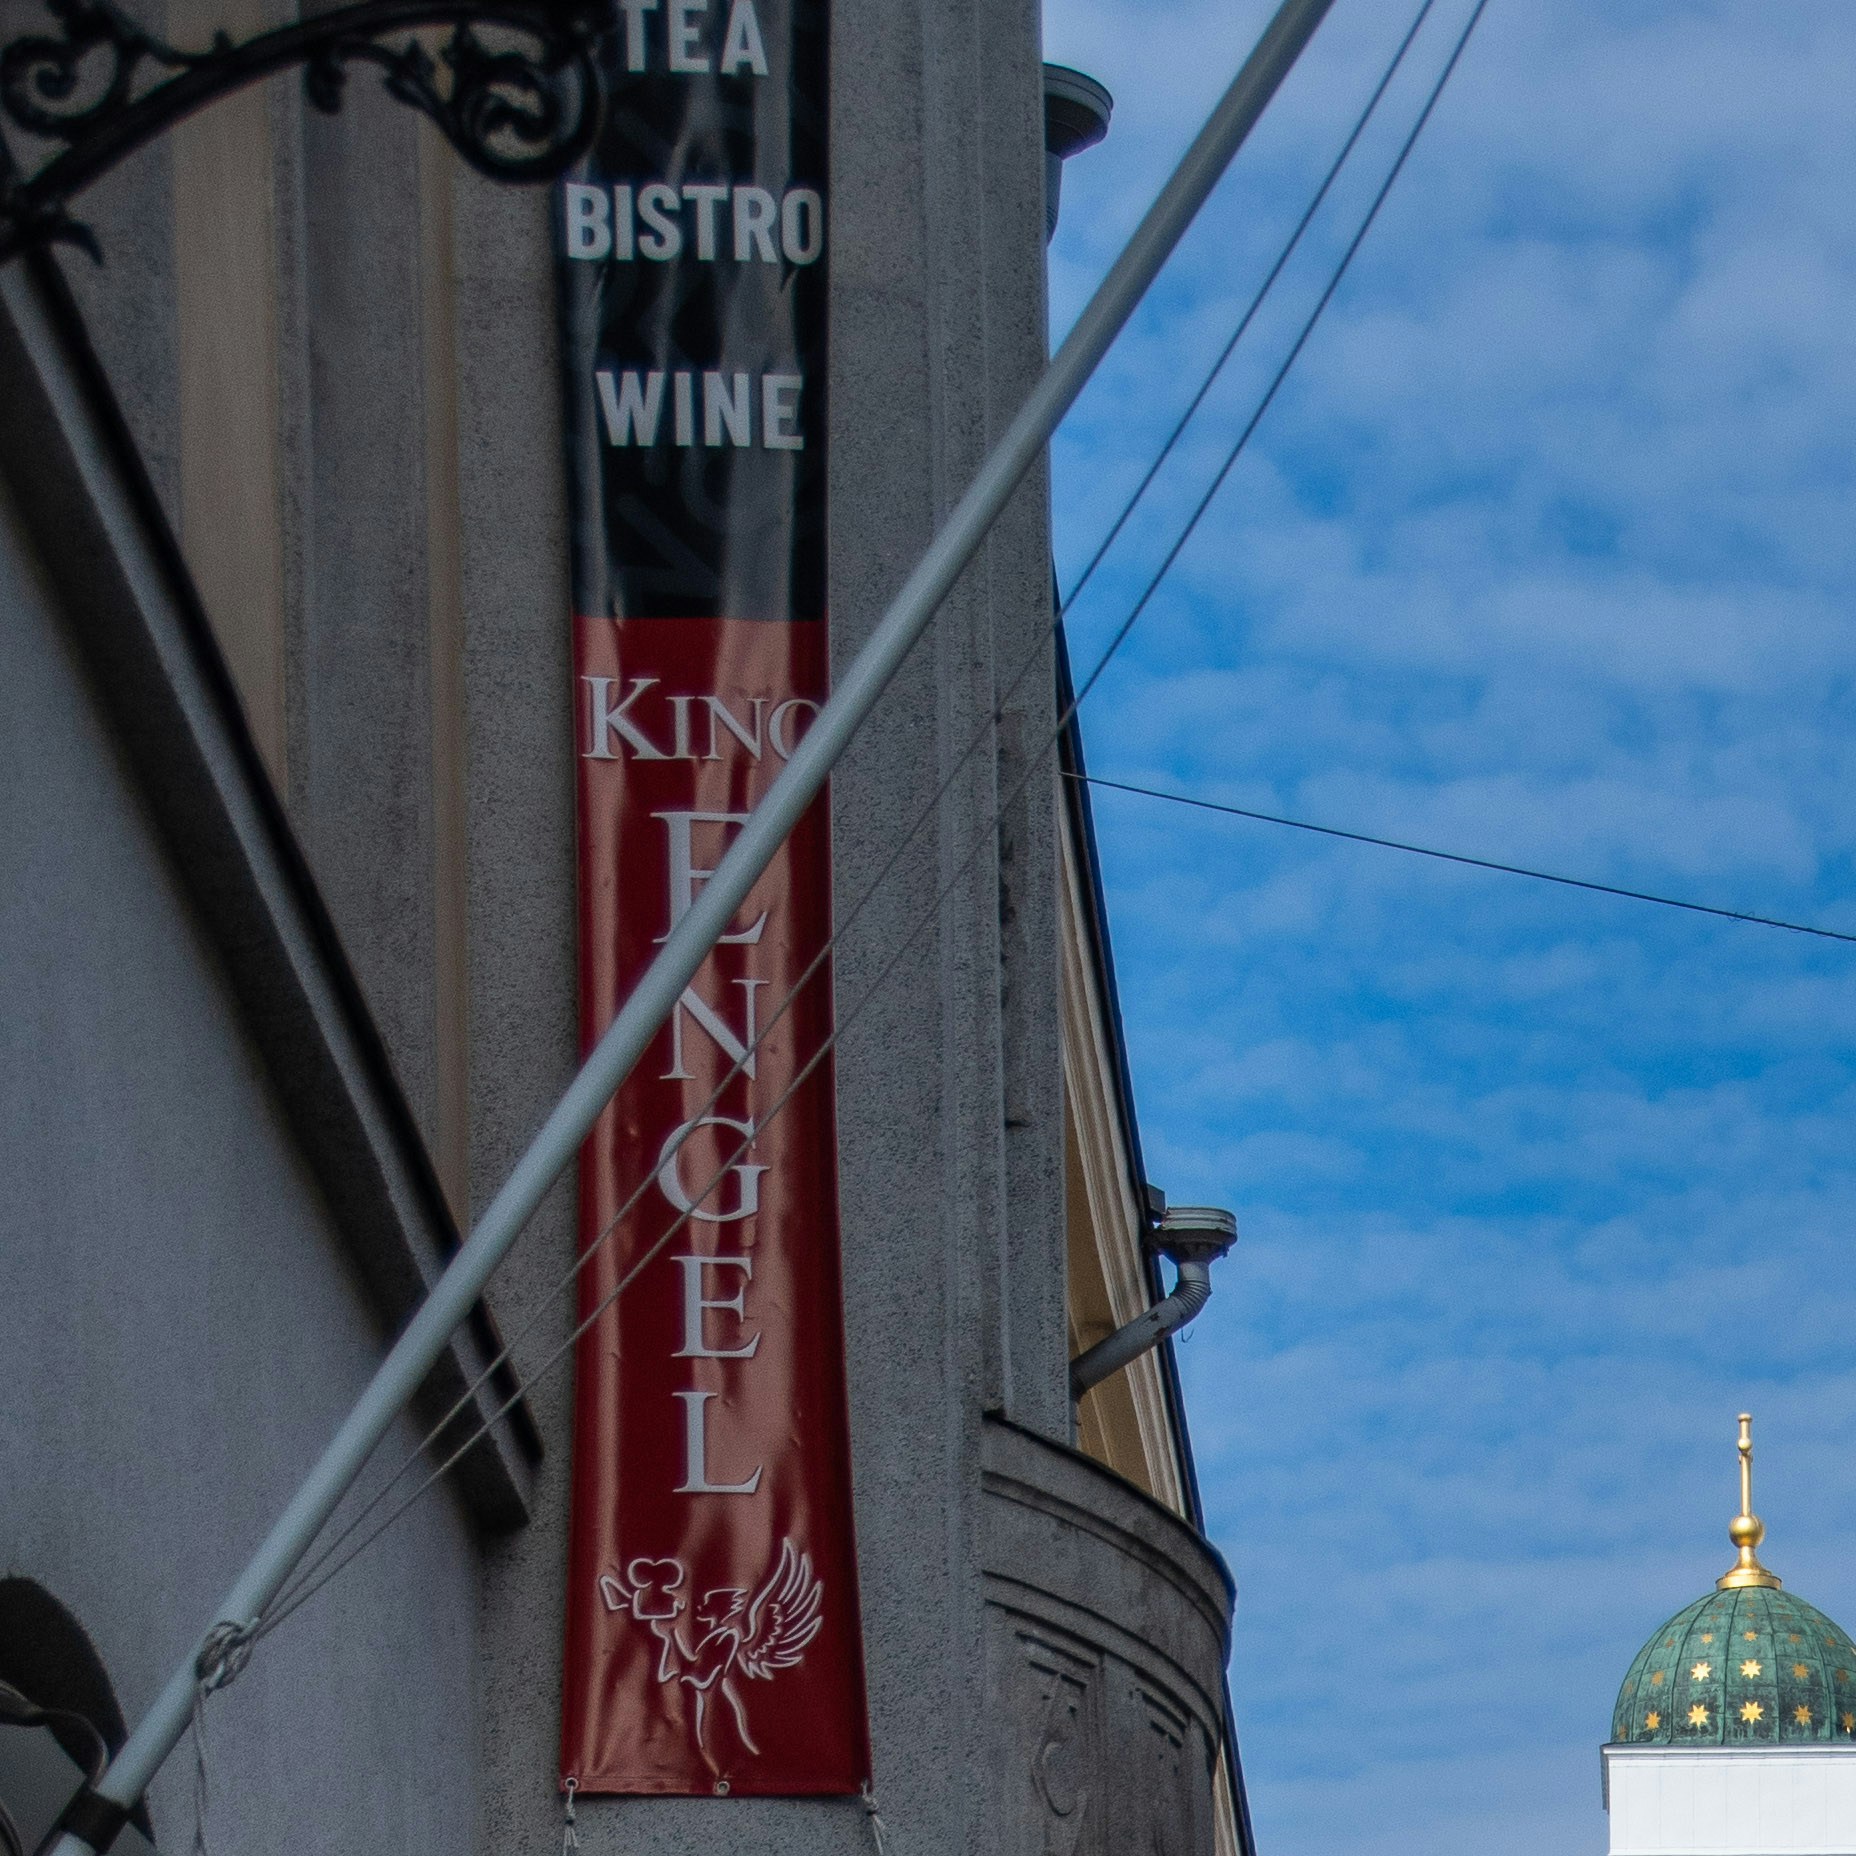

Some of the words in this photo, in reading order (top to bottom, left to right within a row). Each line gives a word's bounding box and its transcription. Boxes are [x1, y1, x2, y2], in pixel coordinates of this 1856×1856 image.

[617, 0, 769, 76] TEA
[565, 182, 824, 266] BISTRO
[595, 371, 805, 450] WINE
[650, 811, 772, 1495] ENGEL
